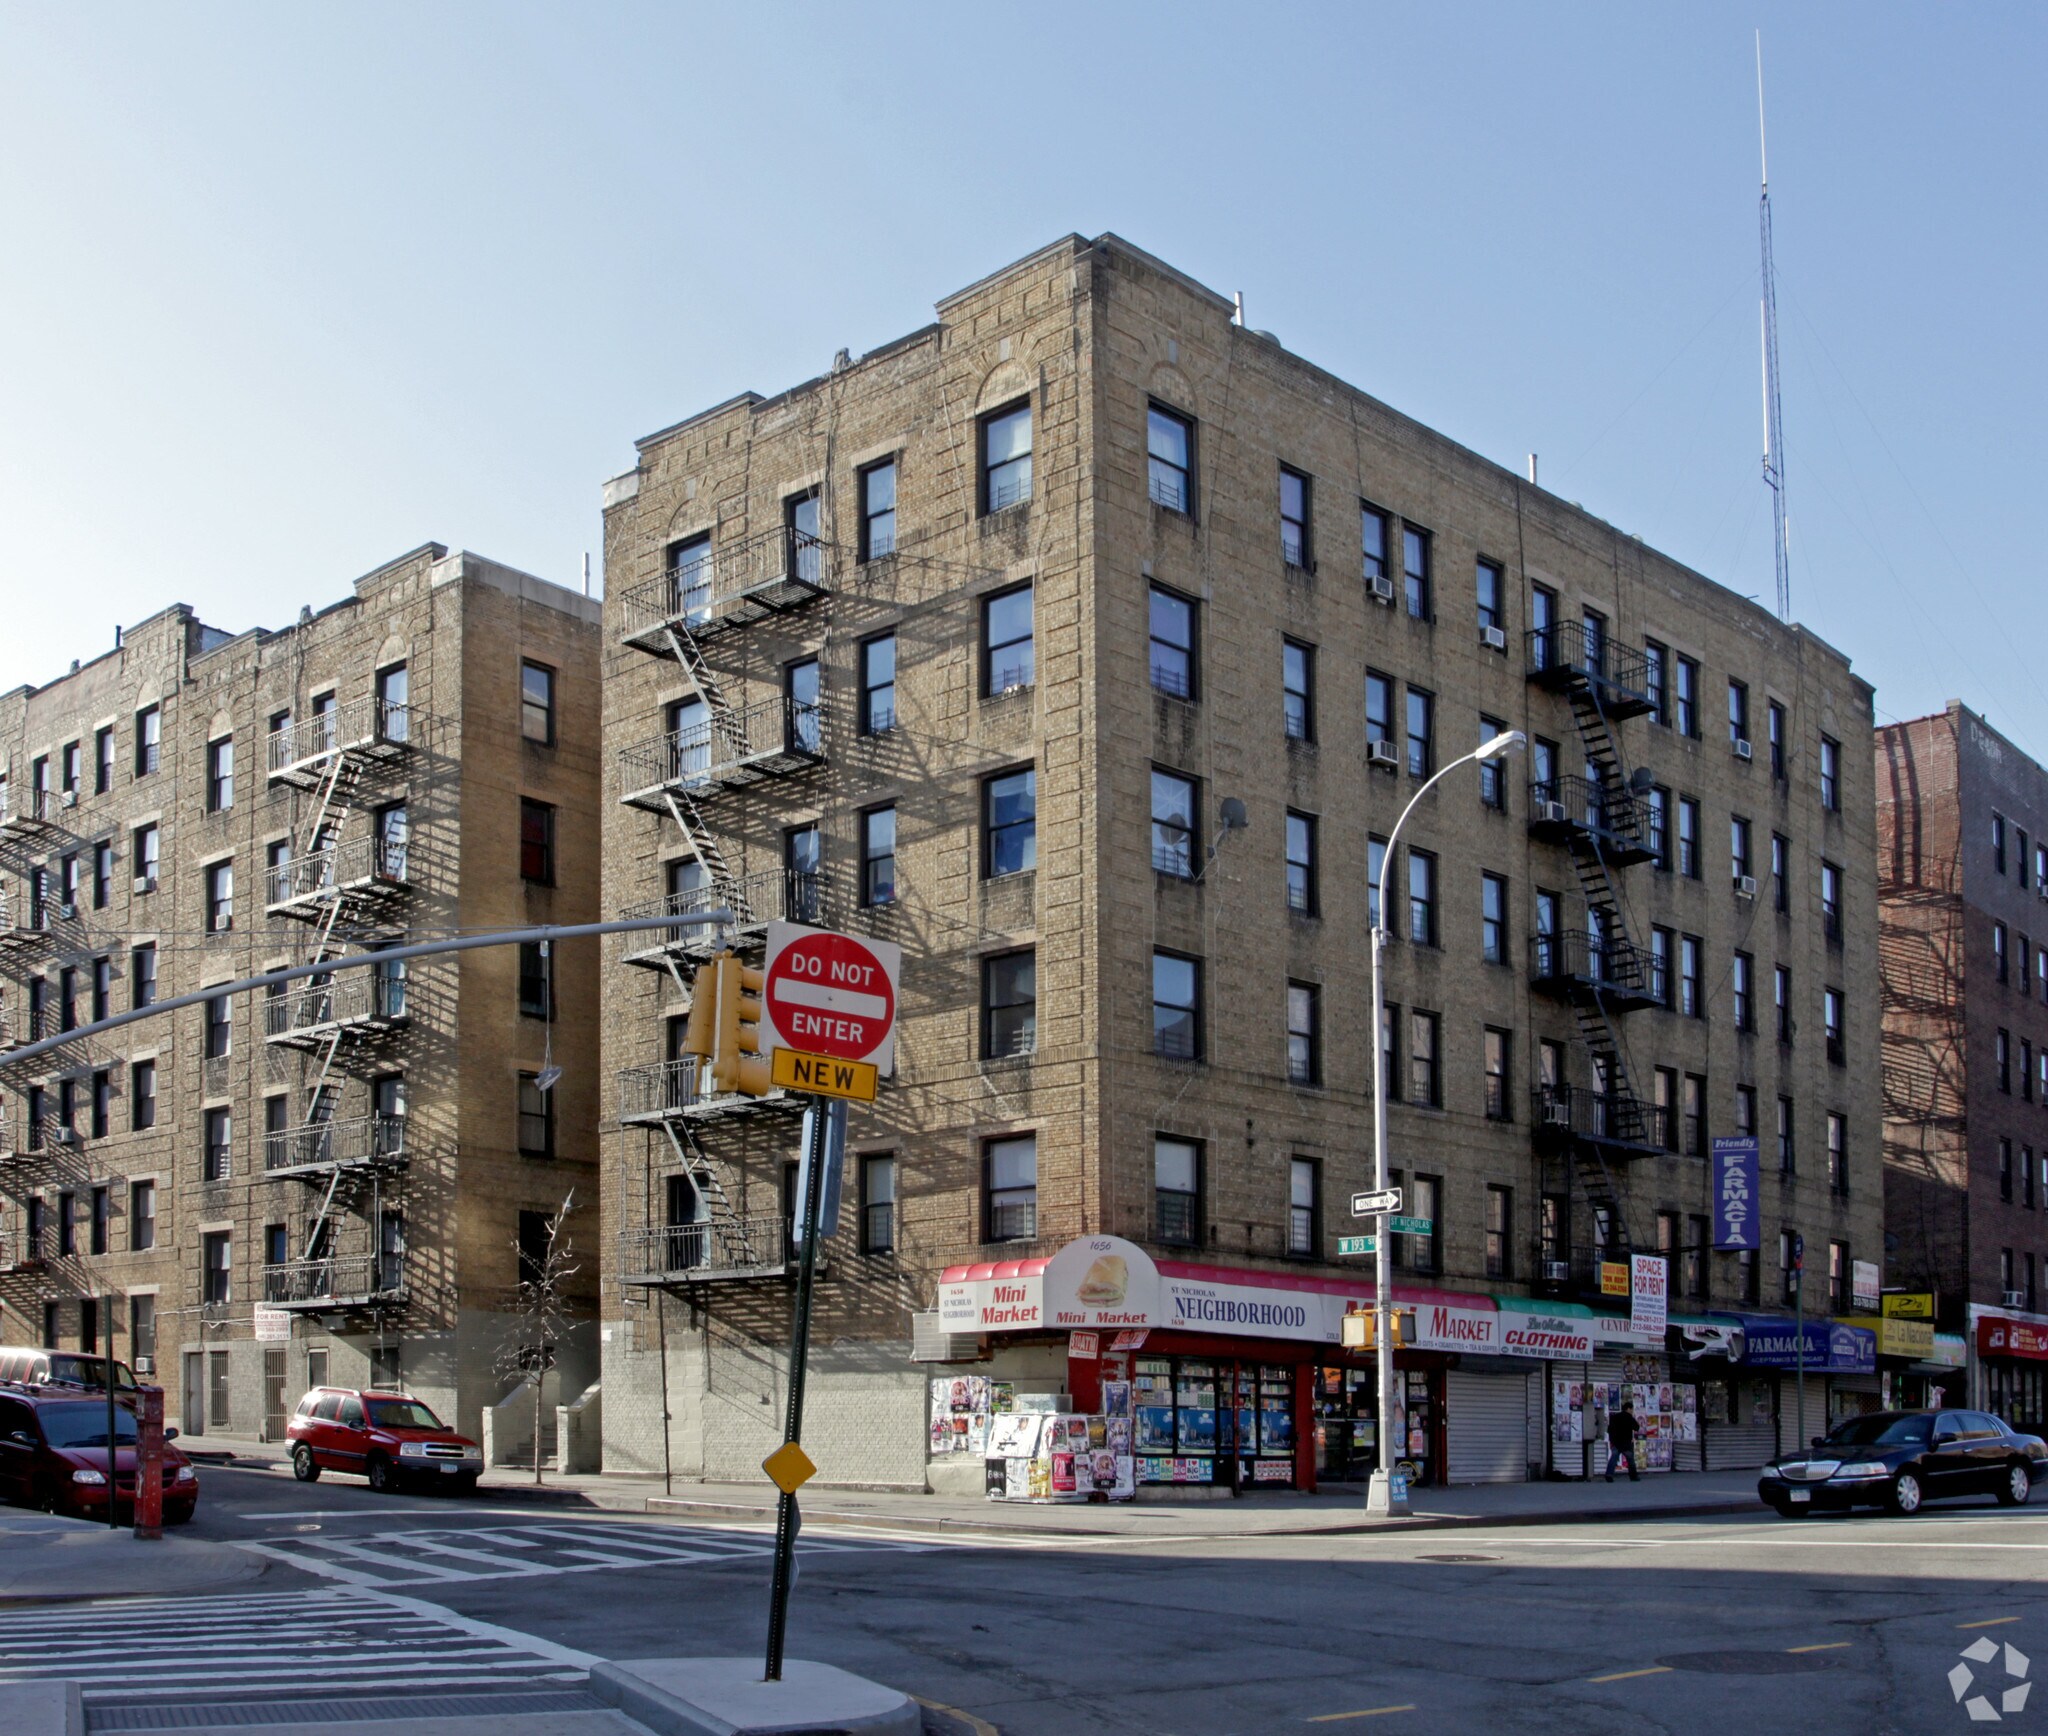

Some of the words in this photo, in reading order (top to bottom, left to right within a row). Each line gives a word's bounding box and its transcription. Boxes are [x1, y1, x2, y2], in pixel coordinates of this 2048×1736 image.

[791, 953, 822, 976] DO
[831, 960, 874, 986] NOT
[792, 1012, 863, 1043] ENTER
[793, 1058, 854, 1090] NEW
[1715, 1139, 1754, 1148] Friendly
[1359, 1199, 1373, 1208] ONE
[1380, 1197, 1394, 1206] WAY
[1723, 1155, 1748, 1244] FARMACIA
[1390, 1217, 1397, 1225] ST
[1400, 1219, 1430, 1229] NICHOLAS
[1090, 1241, 1112, 1251] 1656
[1341, 1240, 1348, 1252] W
[1351, 1239, 1364, 1251] 193
[1637, 1258, 1662, 1276] SPACE
[993, 1285, 1026, 1303] Mini
[1171, 1286, 1179, 1294] ST
[1182, 1287, 1216, 1297] NICHOLAS
[1634, 1275, 1647, 1294] FOR
[1649, 1277, 1664, 1296] RENT
[951, 1298, 971, 1307] NICHOLAS
[943, 1310, 975, 1319] NEIGHBORHOOD
[981, 1305, 1039, 1324] Market
[1056, 1312, 1086, 1323] Mini
[1096, 1312, 1147, 1323] Market
[1175, 1297, 1305, 1327] NEIGHBORHOOD
[1505, 1330, 1588, 1350] CLOTHING
